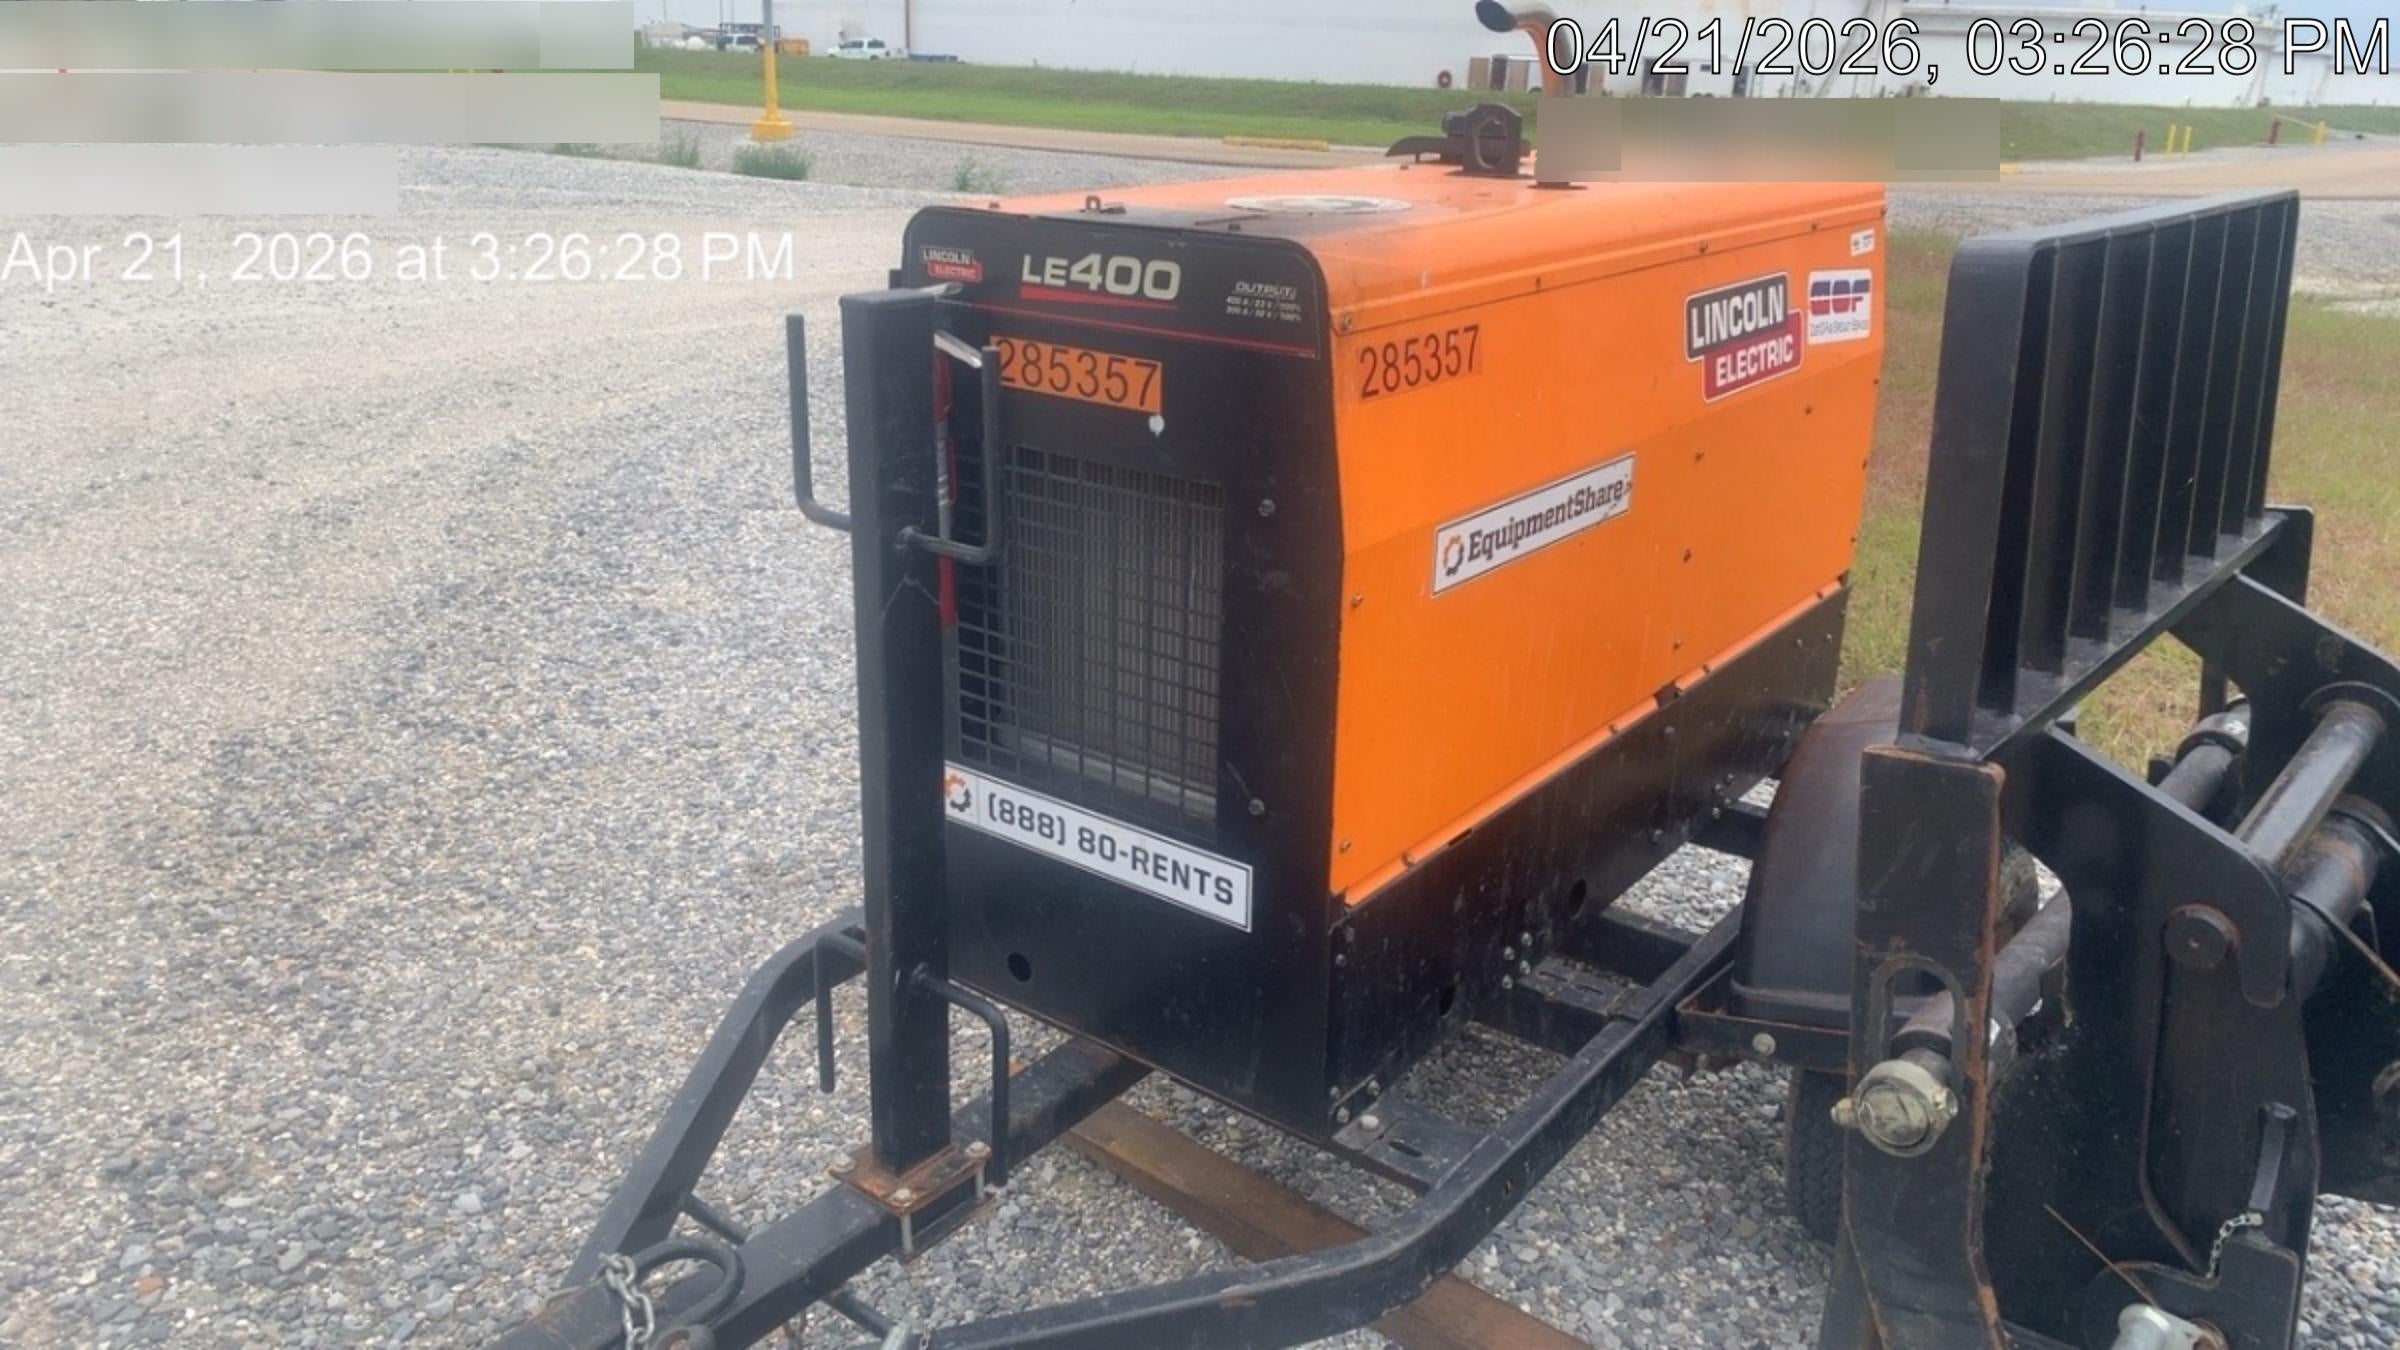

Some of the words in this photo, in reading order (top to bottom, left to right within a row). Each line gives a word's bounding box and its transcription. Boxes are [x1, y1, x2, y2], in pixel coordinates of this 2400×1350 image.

[922, 249, 972, 265] LINCOLN
[934, 264, 977, 280] ELECTRIC
[1022, 253, 1181, 300] LE400
[1691, 283, 1784, 349] LINCOLN
[995, 339, 1158, 407] 285357
[1360, 323, 1479, 399] 285357
[1715, 334, 1794, 388] ELECTRIC
[1466, 477, 1625, 562] EquipmentShare
[988, 792, 1067, 846] (888)
[1077, 826, 1234, 906] 80-RENTS
